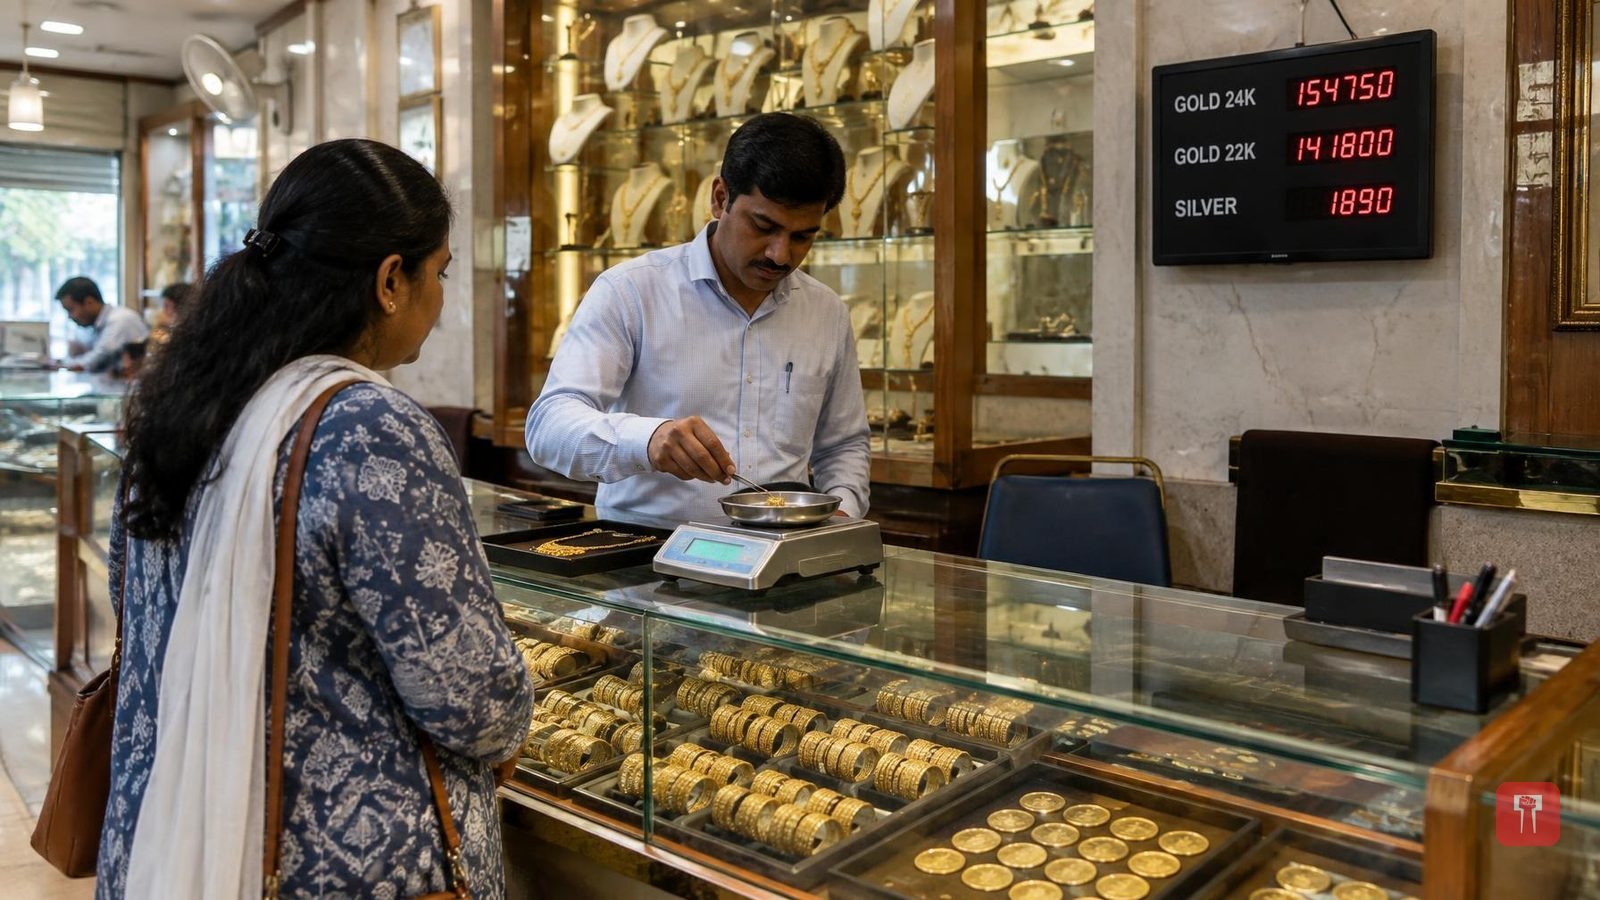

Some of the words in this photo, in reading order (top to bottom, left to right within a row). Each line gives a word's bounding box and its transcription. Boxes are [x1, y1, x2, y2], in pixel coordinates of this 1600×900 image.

[1174, 93, 1221, 113] GOLD
[1224, 87, 1256, 109] 24K
[1298, 70, 1394, 106] 154750
[1174, 145, 1221, 165] GOLD
[1224, 142, 1256, 162] 22K
[1298, 128, 1394, 161] 141800
[1174, 197, 1238, 217] SILVER
[1331, 187, 1393, 215] 1890
